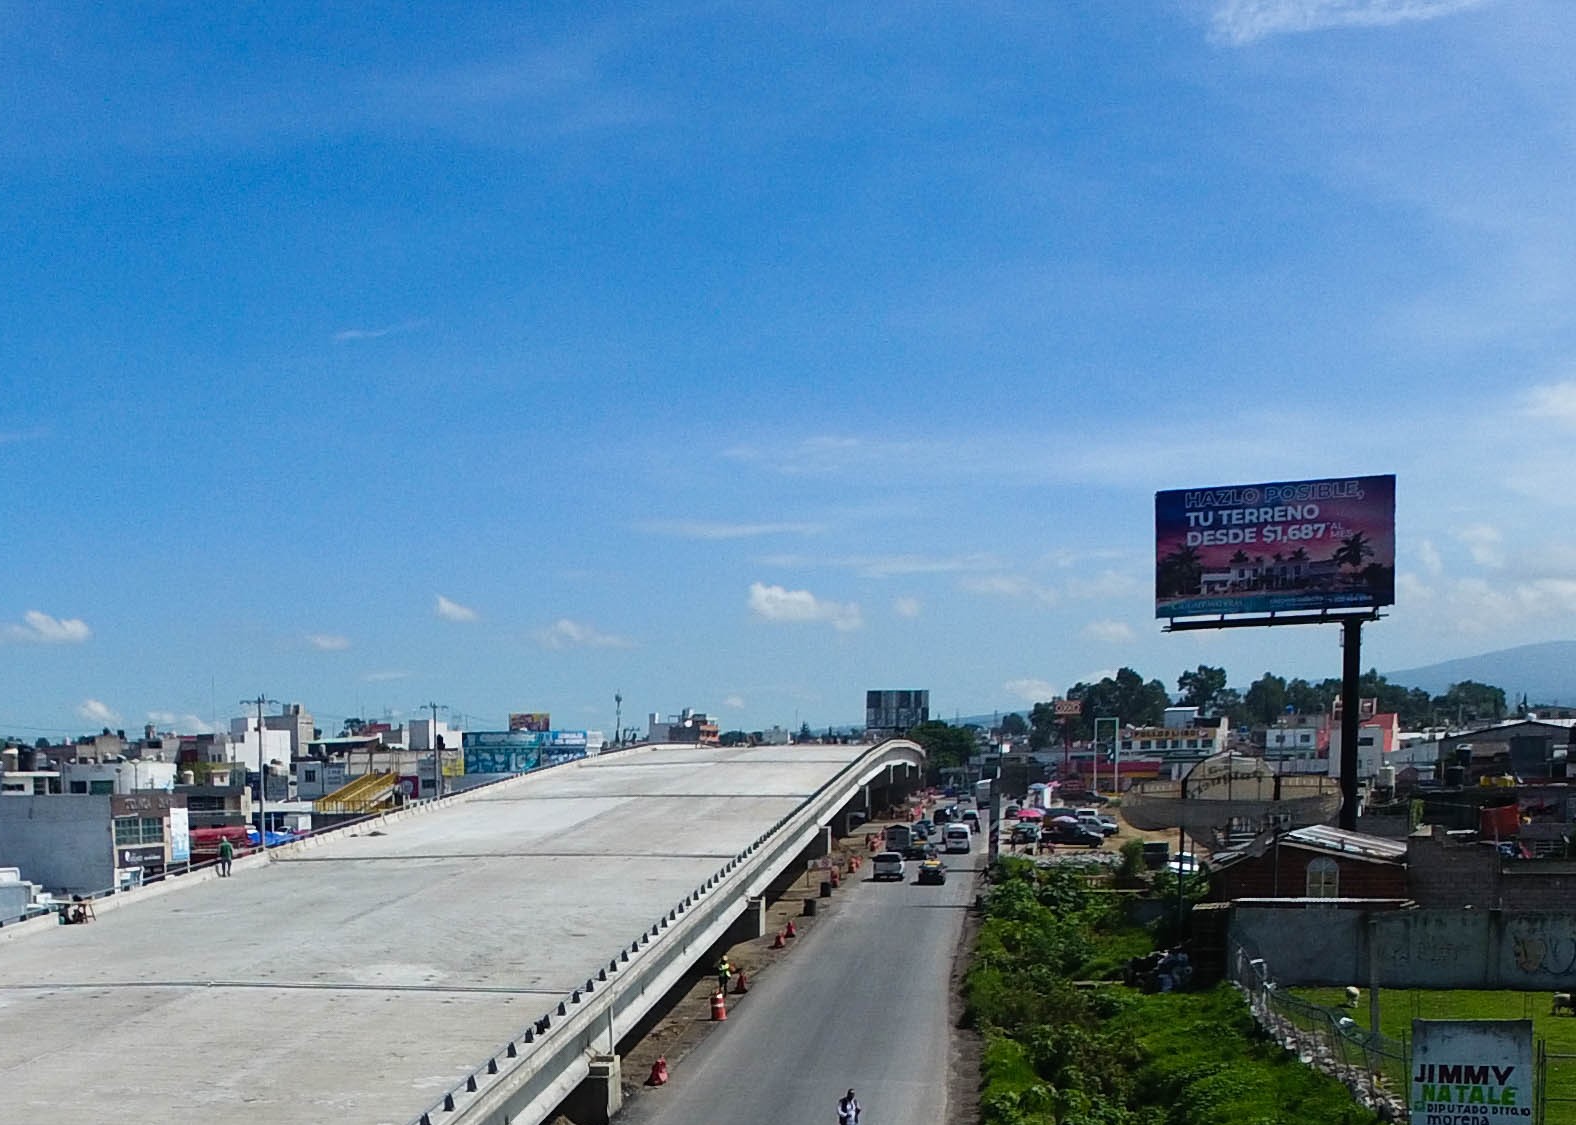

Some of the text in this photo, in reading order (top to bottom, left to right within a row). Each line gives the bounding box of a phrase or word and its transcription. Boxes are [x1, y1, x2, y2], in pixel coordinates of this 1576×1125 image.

[1185, 480, 1365, 508] HAZLO POSIBLE,
[1185, 504, 1320, 527] TU TERRENO
[1187, 528, 1257, 546] DESDE
[1414, 1064, 1515, 1086] JIMMY
[1422, 1084, 1518, 1106] NATALE
[1427, 1103, 1489, 1114] DIPUTADO
